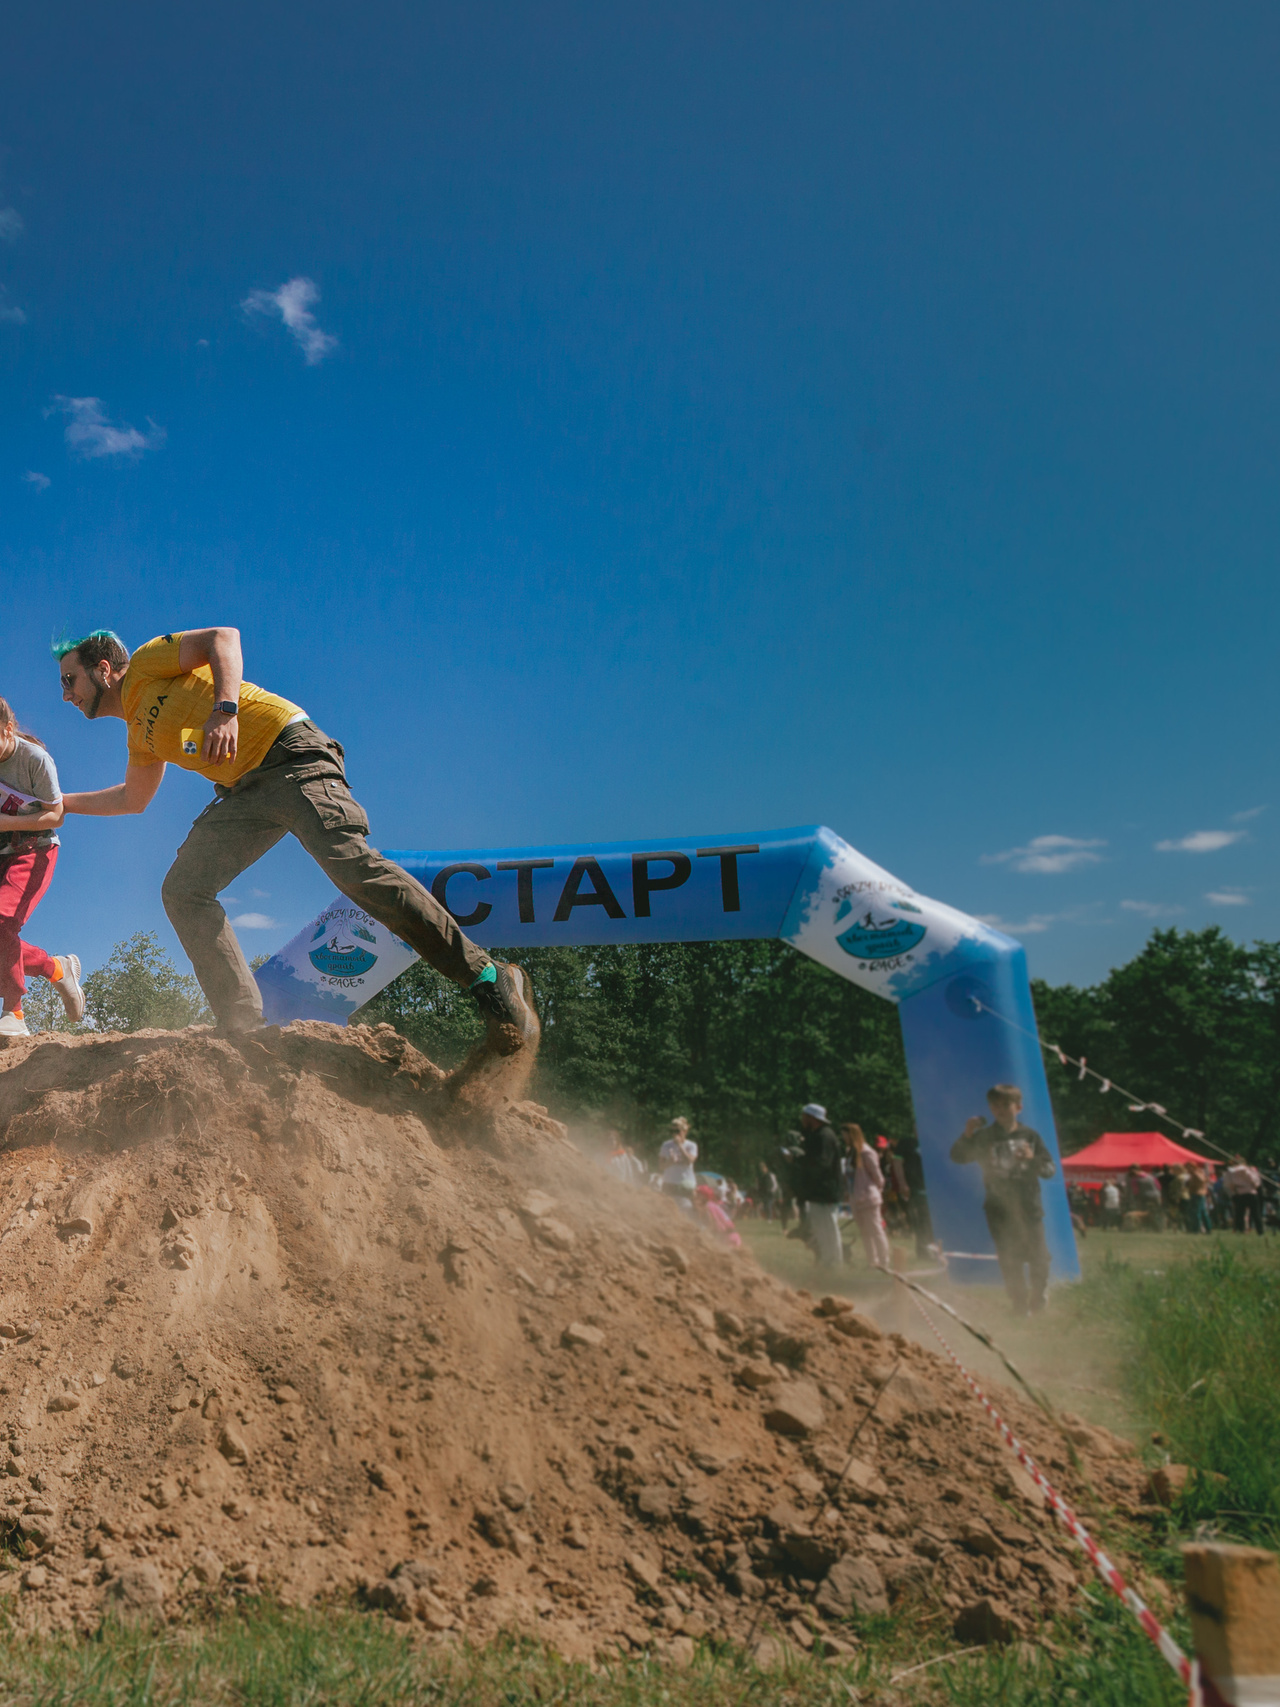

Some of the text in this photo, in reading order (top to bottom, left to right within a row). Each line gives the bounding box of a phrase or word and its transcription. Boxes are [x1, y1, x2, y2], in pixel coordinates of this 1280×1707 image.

[430, 844, 760, 927] СТАРТ
[320, 908, 372, 924] CRAZY DOG
[328, 976, 359, 989] RACE
